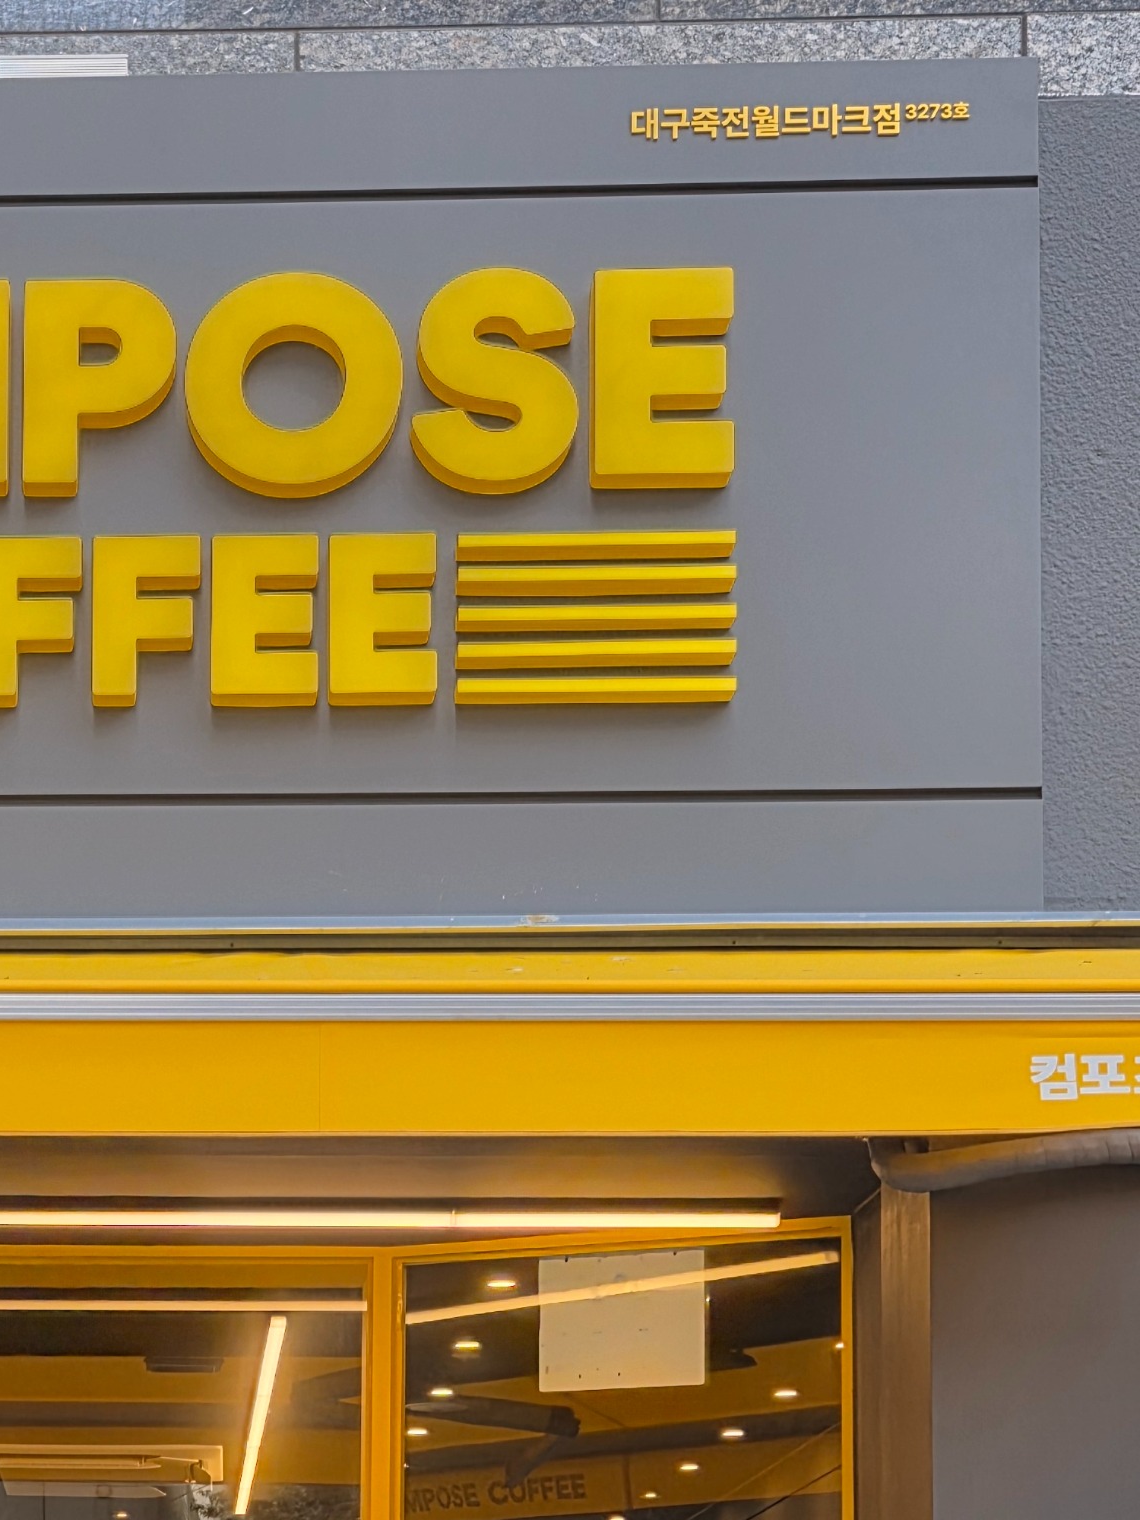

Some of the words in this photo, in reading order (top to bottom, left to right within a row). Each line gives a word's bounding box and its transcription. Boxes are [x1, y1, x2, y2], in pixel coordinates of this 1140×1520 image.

[630, 102, 902, 140] 대구죽전월드마크점
[905, 101, 971, 121] 3273호
[1030, 1053, 1140, 1101] 컴포
